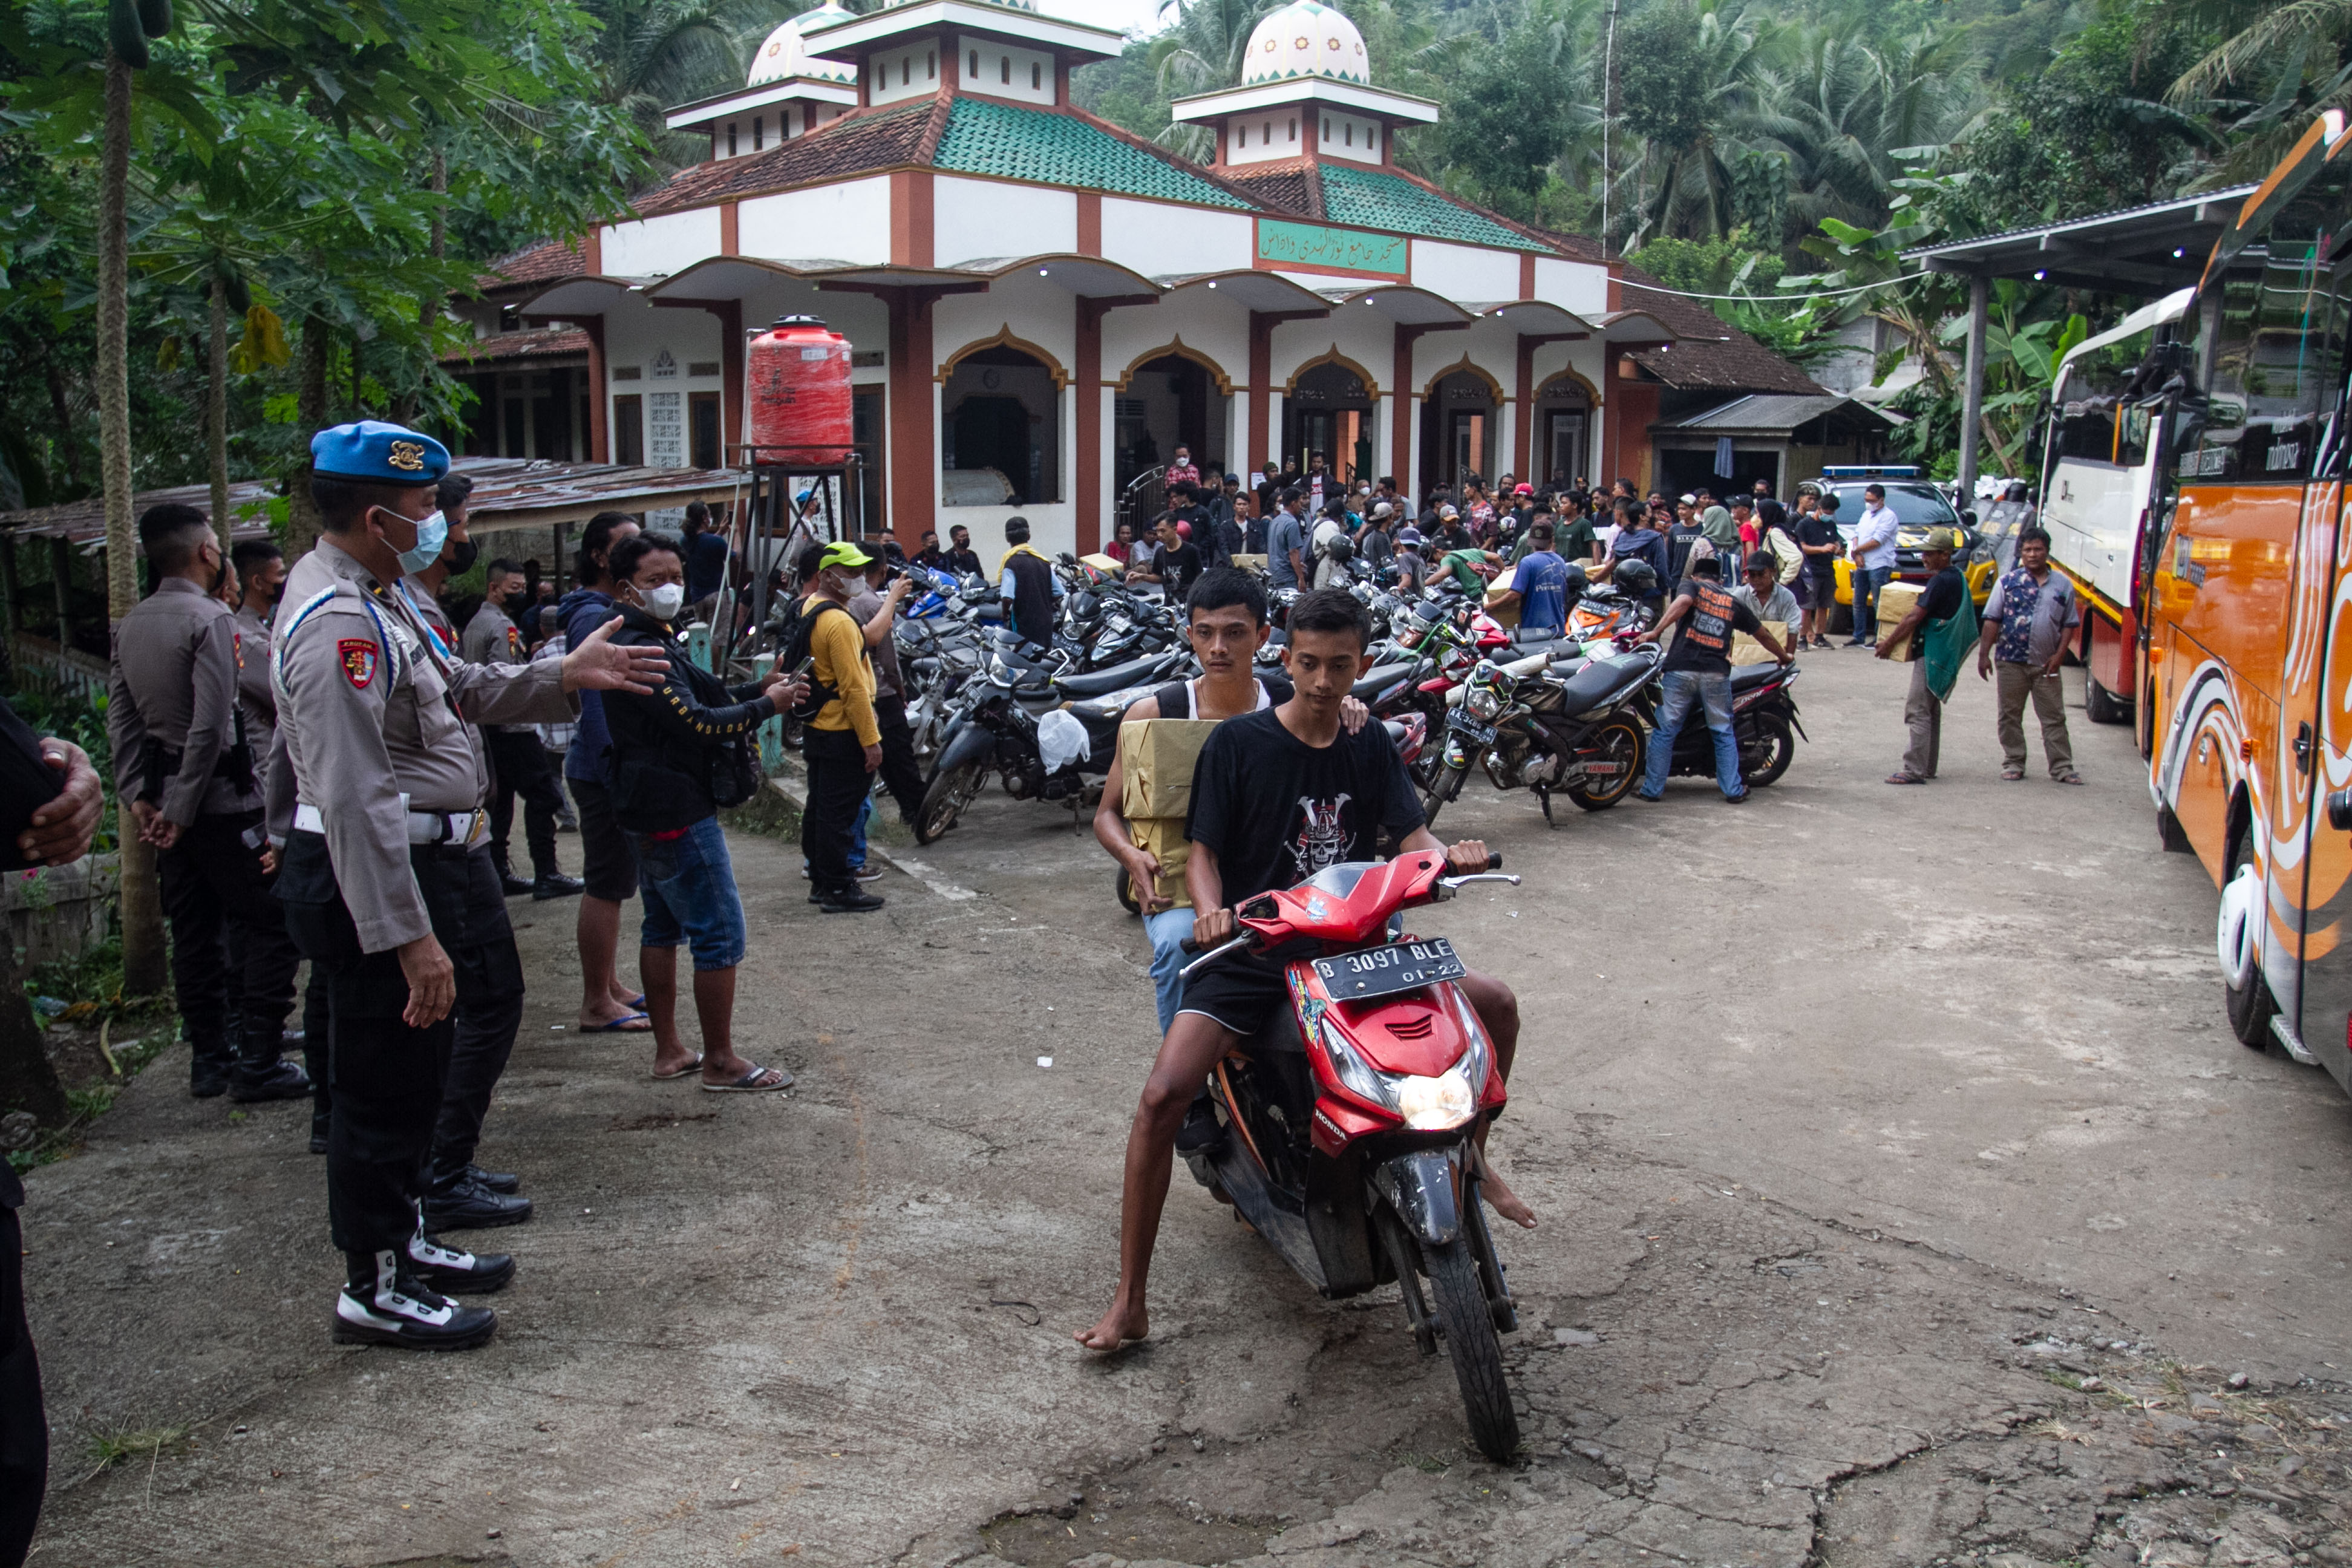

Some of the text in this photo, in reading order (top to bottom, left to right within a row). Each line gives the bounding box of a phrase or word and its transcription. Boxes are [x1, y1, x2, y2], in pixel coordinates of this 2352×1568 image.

[1589, 764, 1615, 773] YAMAHA
[1317, 939, 1452, 979] B 3097 BLE
[1315, 1109, 1348, 1142] HONDA
